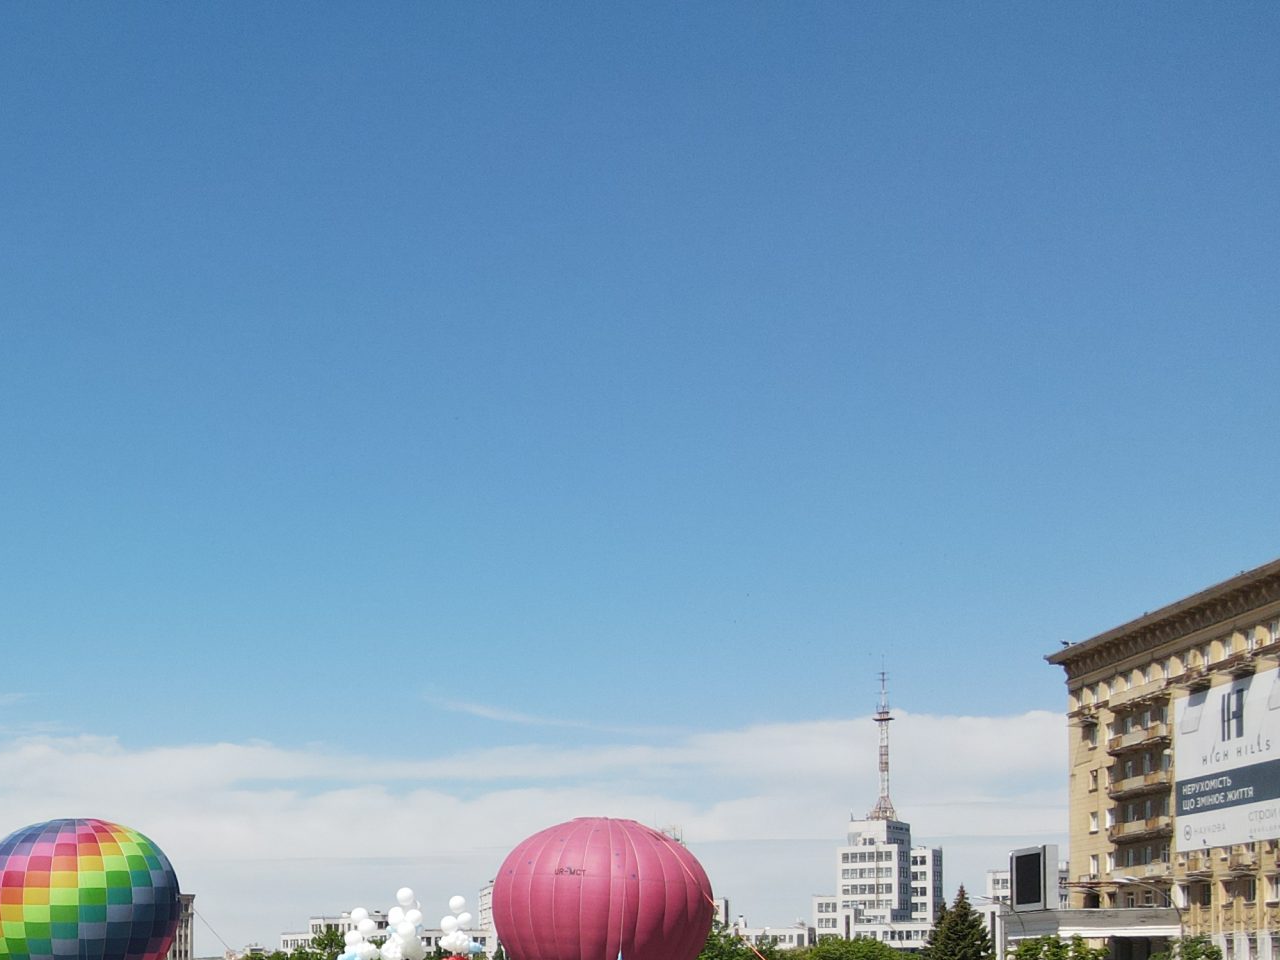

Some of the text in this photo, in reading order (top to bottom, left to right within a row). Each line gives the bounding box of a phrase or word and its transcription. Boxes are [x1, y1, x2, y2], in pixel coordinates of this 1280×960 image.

[1202, 739, 1271, 765] HIGH HILLS
[1182, 776, 1232, 796] НЕРУХОМІСТЬ
[1182, 786, 1254, 810] ЩО ЗМІНЮЄ ЖИТТЯ
